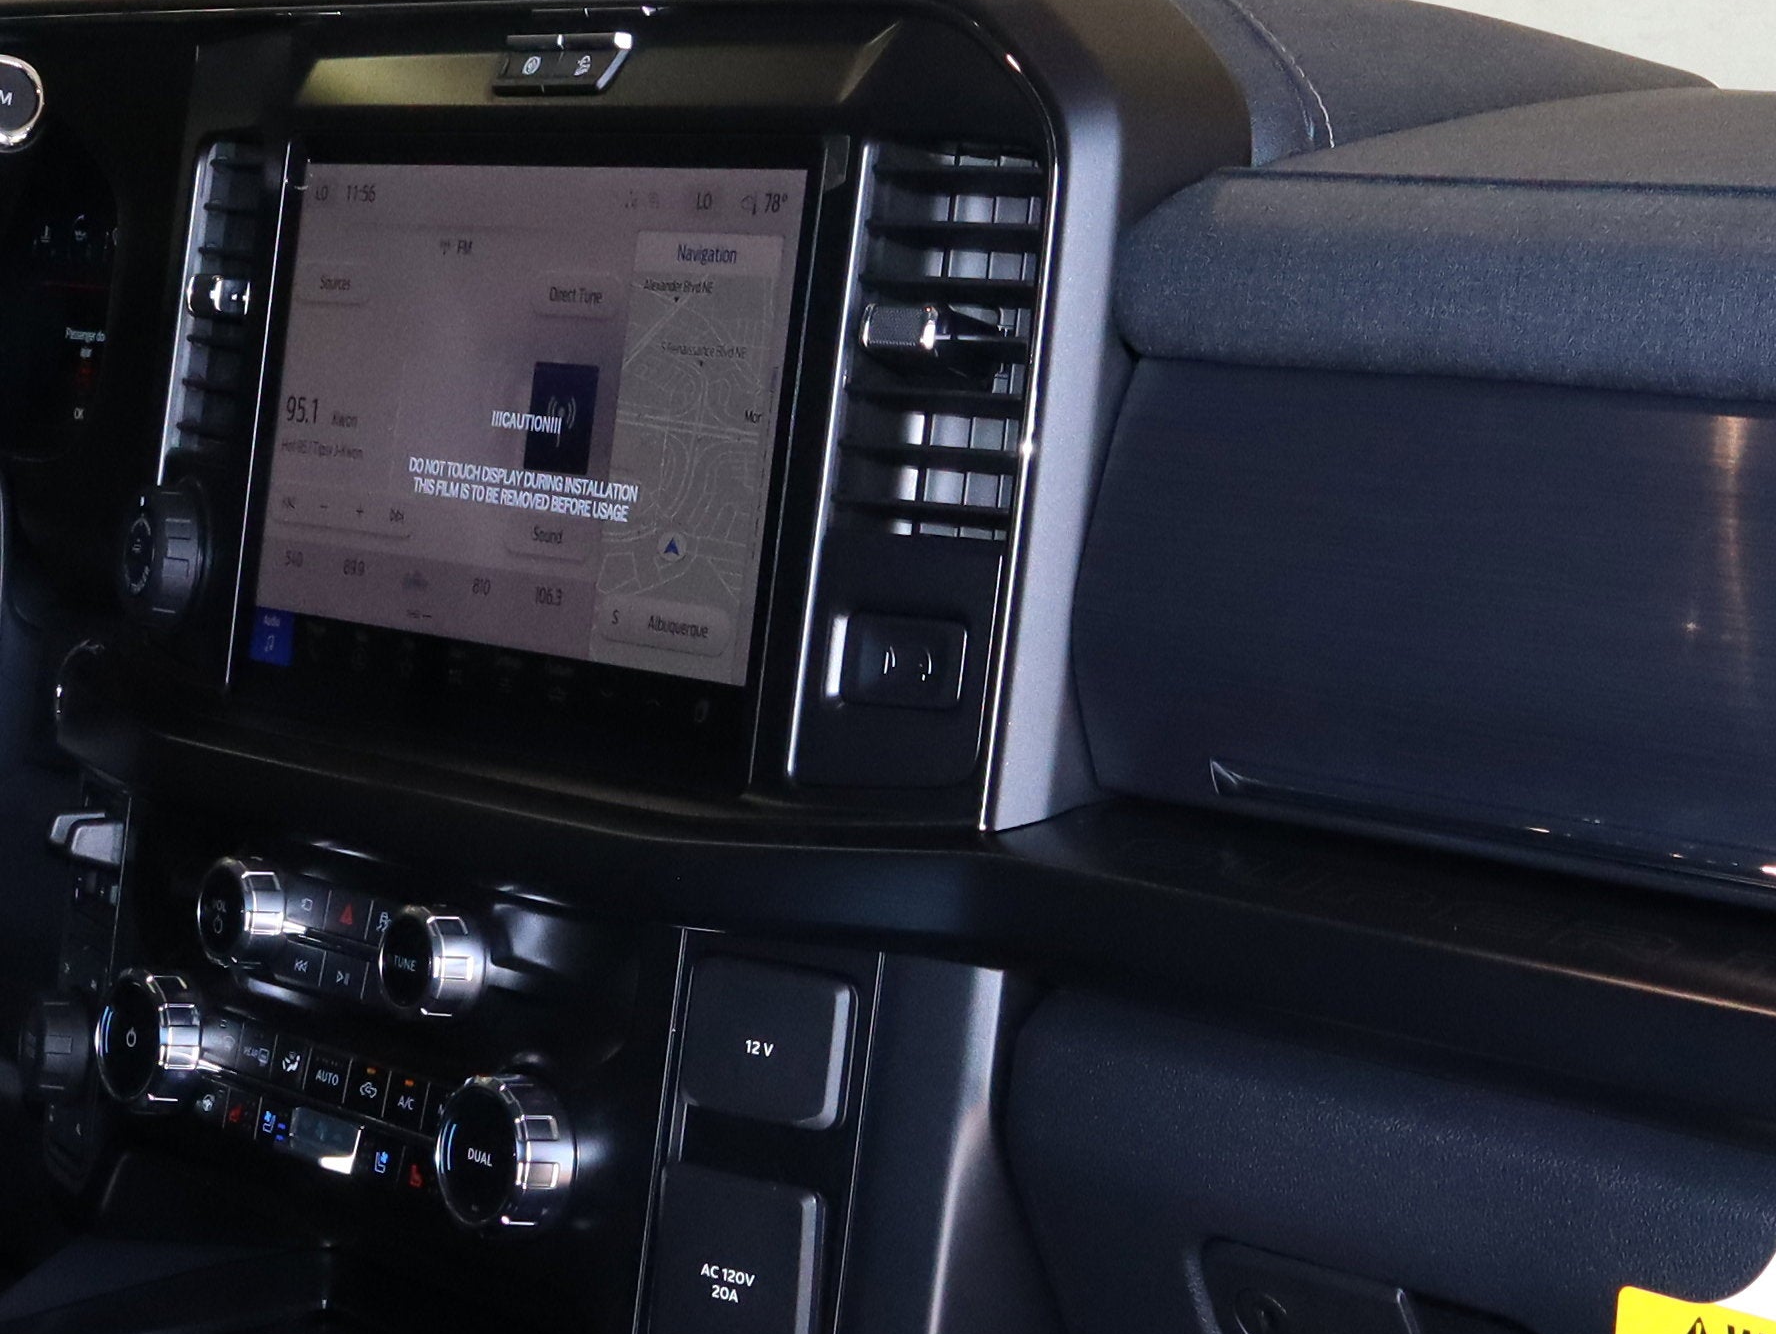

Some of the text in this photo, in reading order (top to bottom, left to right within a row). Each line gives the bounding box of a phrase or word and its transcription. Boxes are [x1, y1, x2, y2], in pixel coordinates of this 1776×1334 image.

[676, 244, 738, 266] Navigation
[548, 287, 573, 303] Direct
[284, 395, 320, 425] 95.1
[409, 457, 638, 502] DO NOT TOUCH DISPLAY DURING INSTALLATION
[414, 477, 630, 522] THIS FILM IS TO BE REMOVED BEFORE USAGE
[646, 614, 710, 639] Albuquerque
[393, 955, 417, 972] TUNE
[745, 1039, 774, 1057] 12 V
[316, 1069, 339, 1086] AUTO
[398, 1094, 416, 1111] A/C
[467, 1147, 492, 1168] DUAL
[700, 1263, 755, 1287] AC 120V
[712, 1284, 739, 1303] 20A
